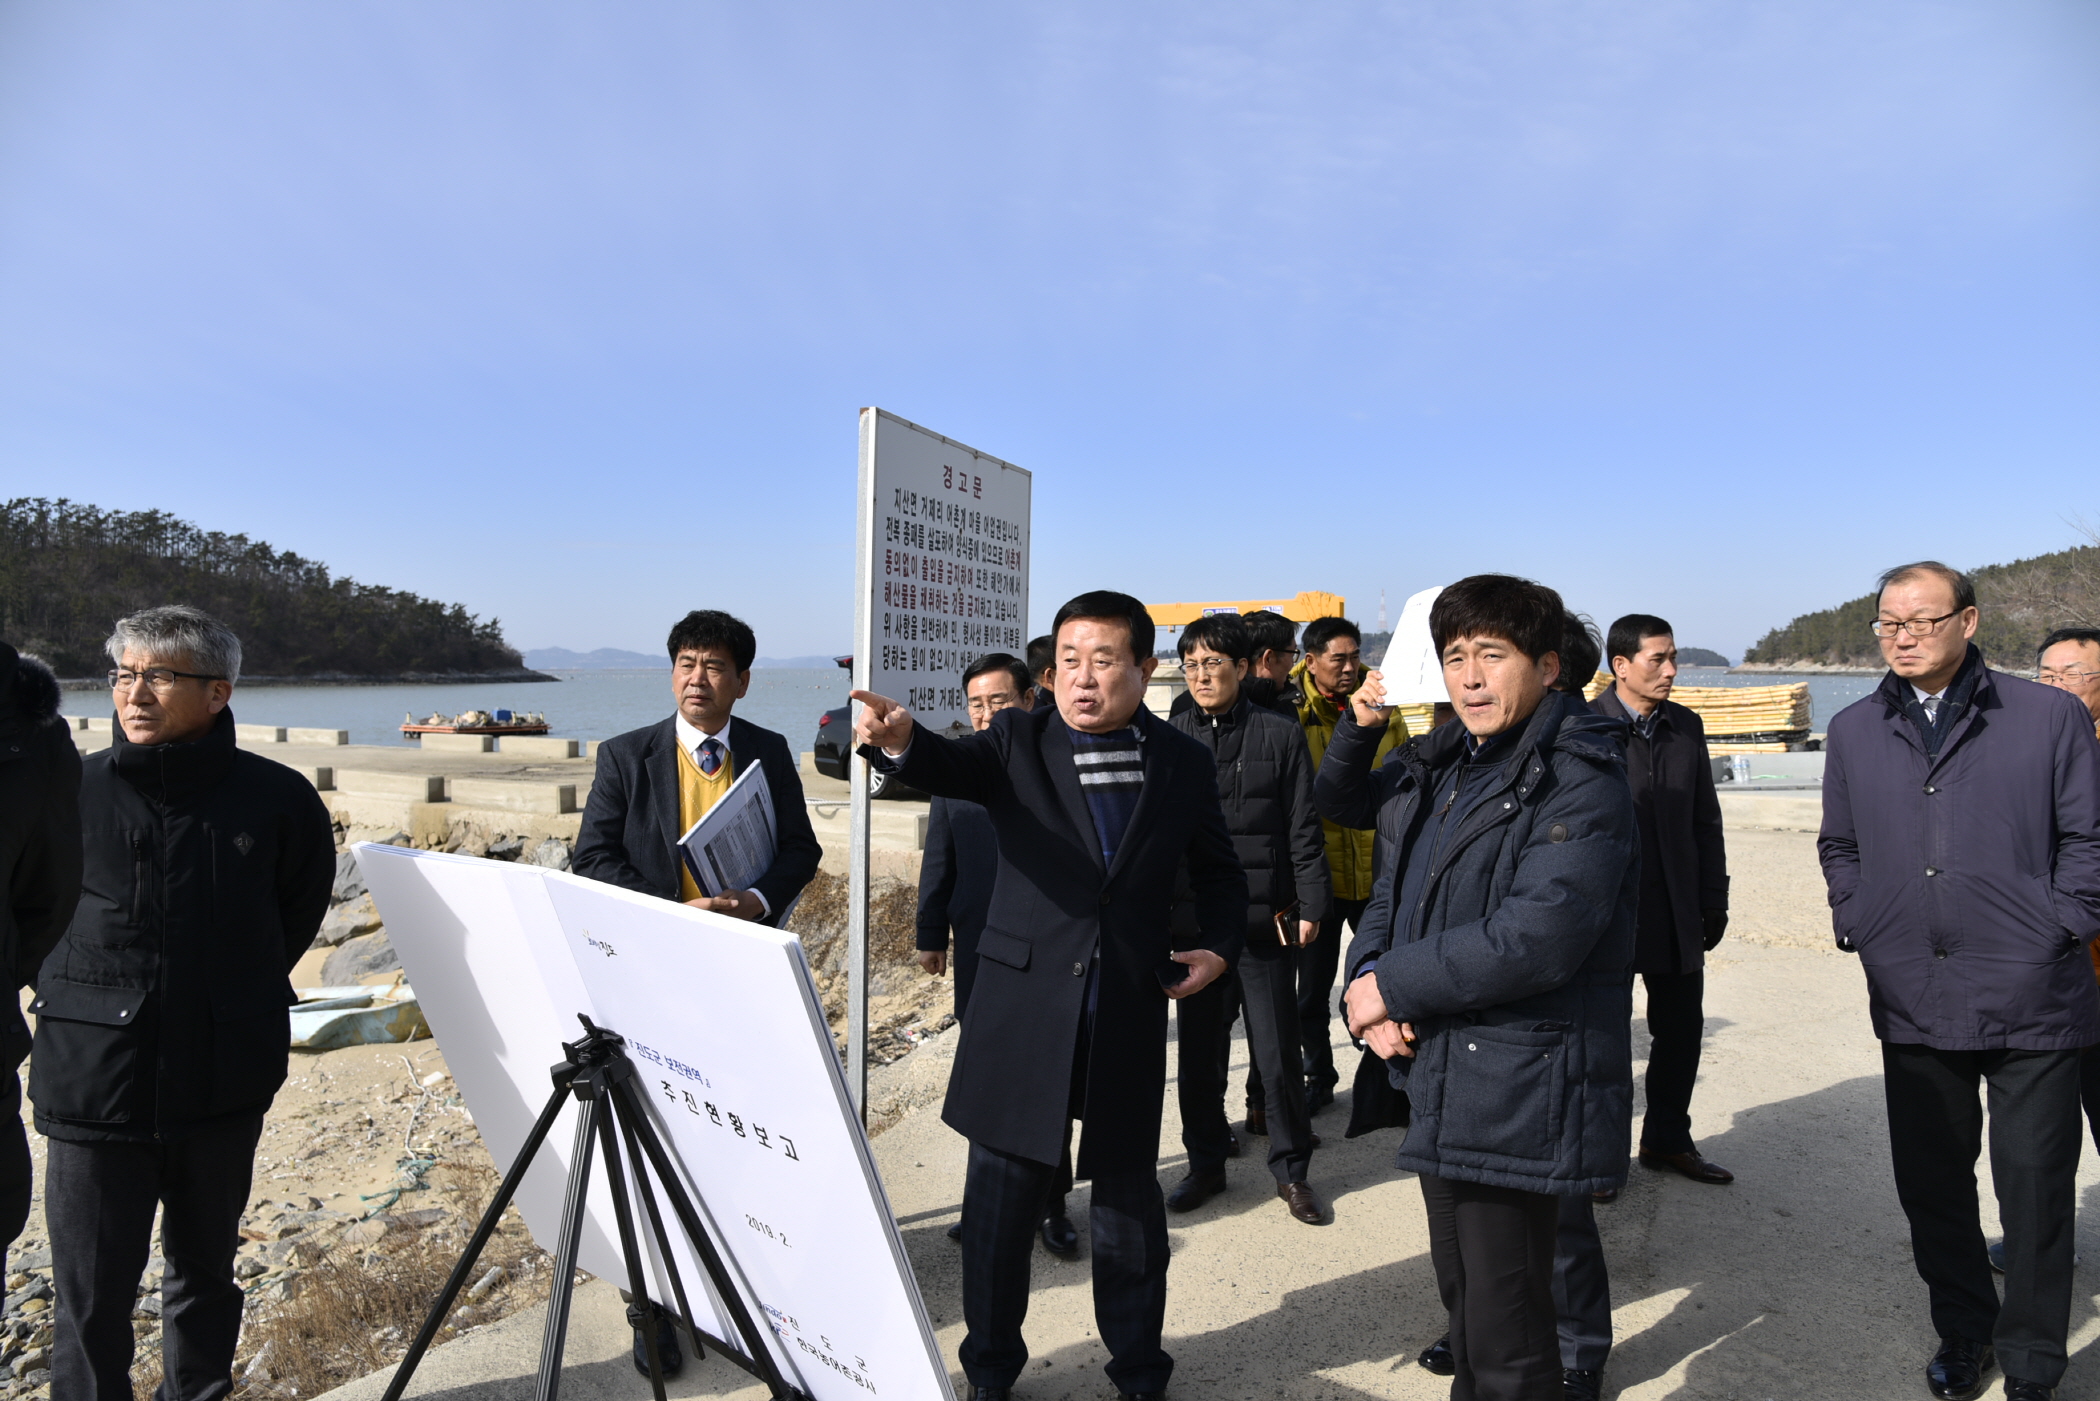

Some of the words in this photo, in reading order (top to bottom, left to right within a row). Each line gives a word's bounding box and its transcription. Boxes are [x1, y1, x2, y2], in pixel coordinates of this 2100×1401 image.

[943, 464, 982, 500] 경고문
[894, 487, 917, 517] 지산면
[921, 496, 943, 525] 거제리
[946, 503, 966, 531] 어촌계
[969, 510, 981, 535] 마을
[983, 515, 1021, 546] 어업권입니다.
[886, 516, 900, 545] 전복
[903, 520, 925, 549] 종패를
[928, 527, 954, 556] 살포하여
[982, 541, 1003, 566] 있으므로
[1004, 548, 1021, 572] 어촌계
[885, 549, 918, 580] 동의없이
[921, 555, 944, 584] 출입을
[947, 561, 973, 590] 금지하며
[976, 568, 988, 591] 또한
[991, 571, 1021, 597] 해안가에서
[884, 581, 917, 610] 해산물을
[920, 586, 949, 614] 채취하는
[952, 592, 965, 616] 것을
[967, 595, 992, 619] 금지하고
[995, 599, 1021, 624] 있습니다.
[883, 612, 891, 639] 위
[894, 613, 918, 640] 사항을
[921, 617, 949, 643] 위반하여
[963, 621, 982, 646] 형사상
[984, 624, 1001, 648] 불이익
[1003, 627, 1020, 650] 처분을
[882, 645, 907, 671] 당하는
[911, 646, 926, 671] 일이
[909, 686, 935, 711] 지산면
[939, 687, 963, 711] 거제리
